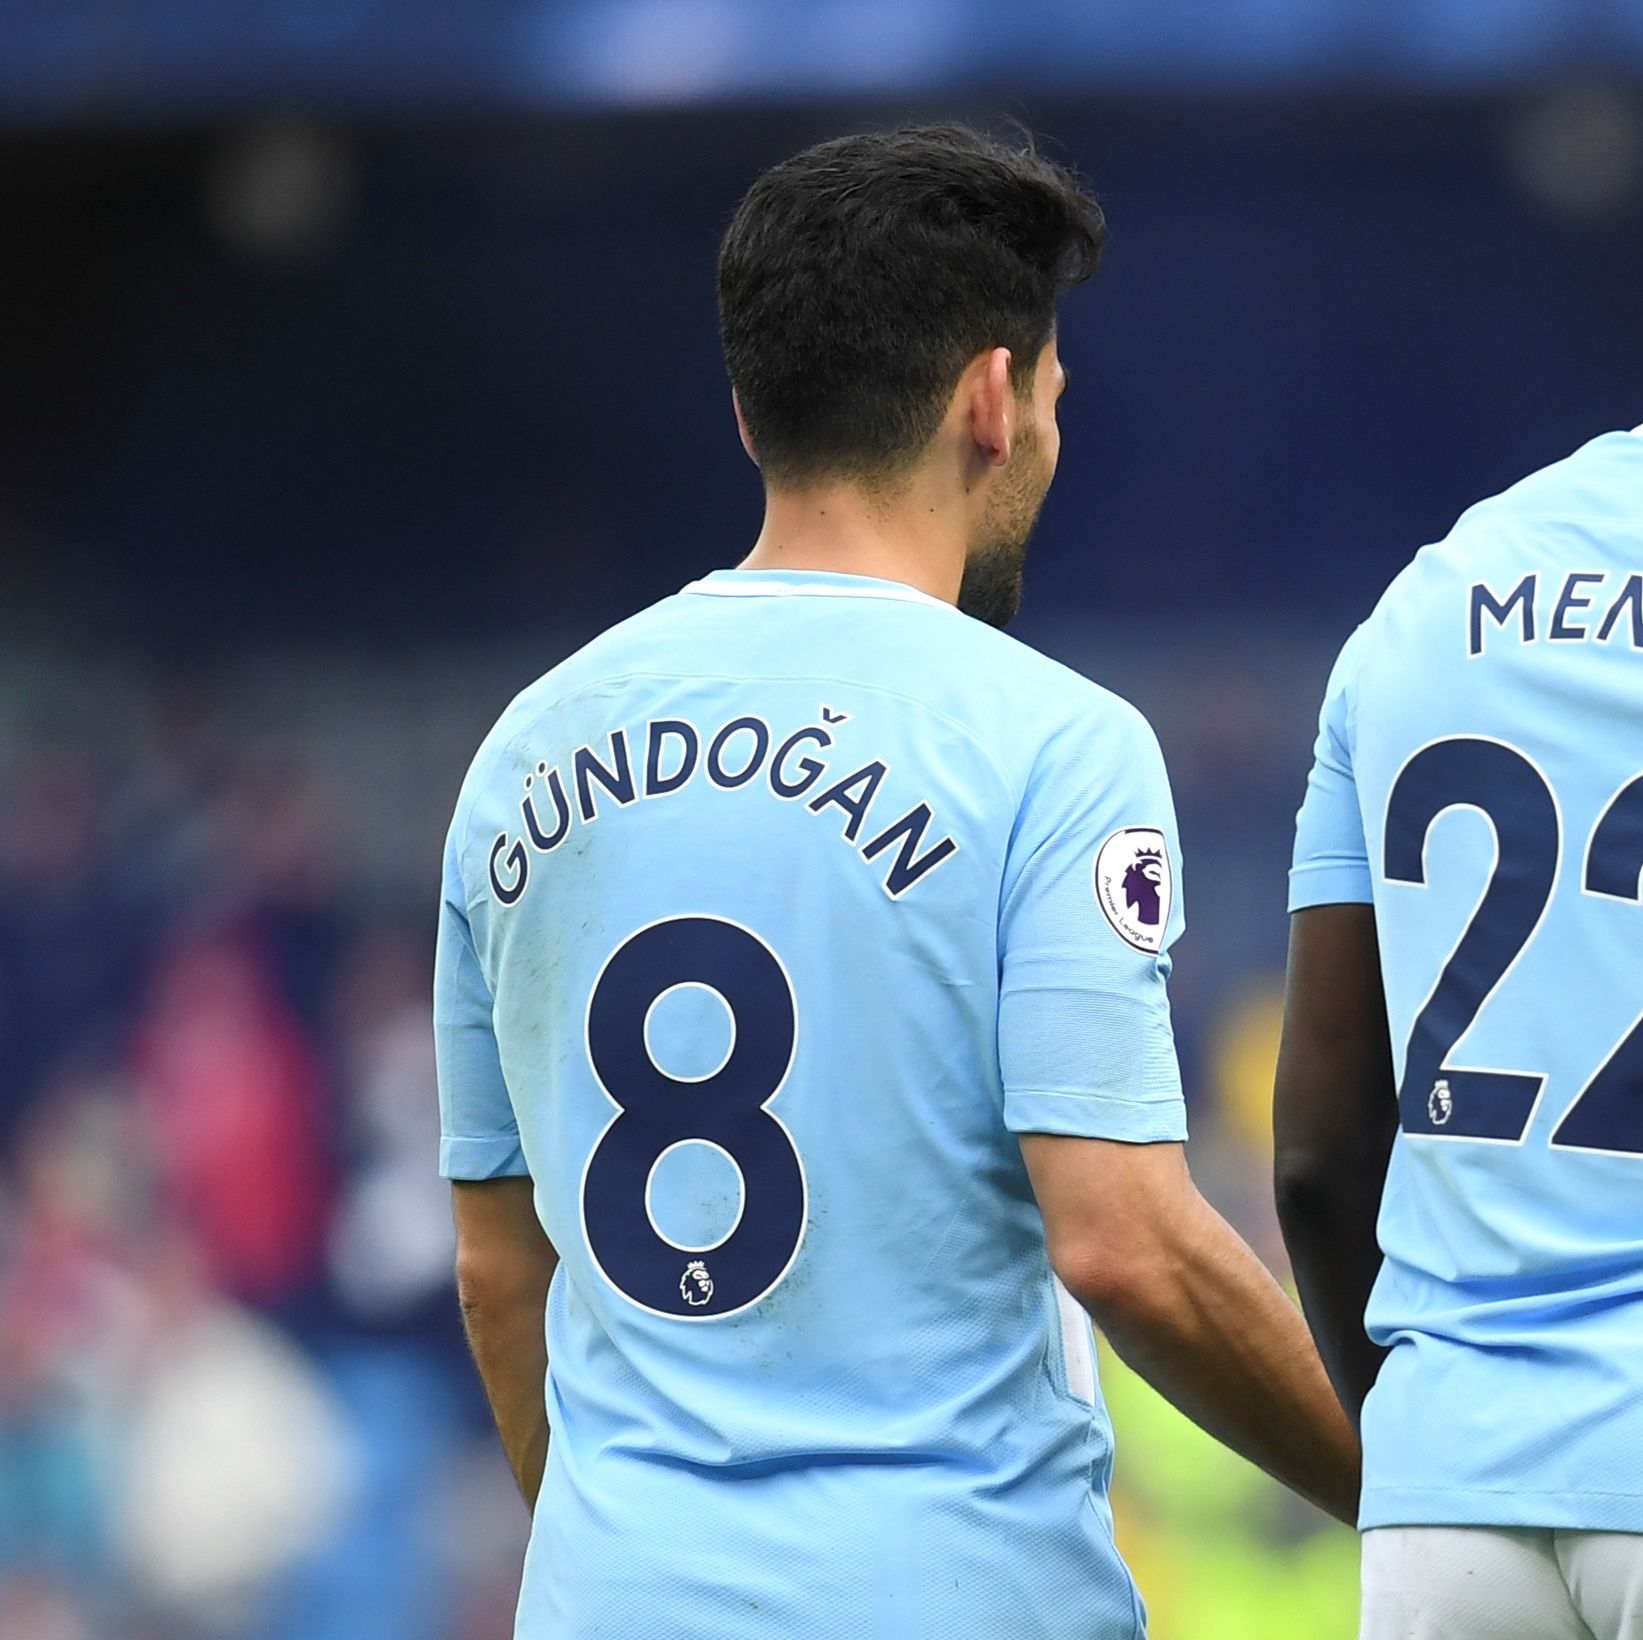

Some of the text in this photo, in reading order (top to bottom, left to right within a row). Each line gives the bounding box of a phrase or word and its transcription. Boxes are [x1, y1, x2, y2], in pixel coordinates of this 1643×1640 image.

[488, 705, 958, 908] GÜNDOĞAN
[1104, 876, 1154, 944] Premier League
[583, 916, 806, 1318] 8
